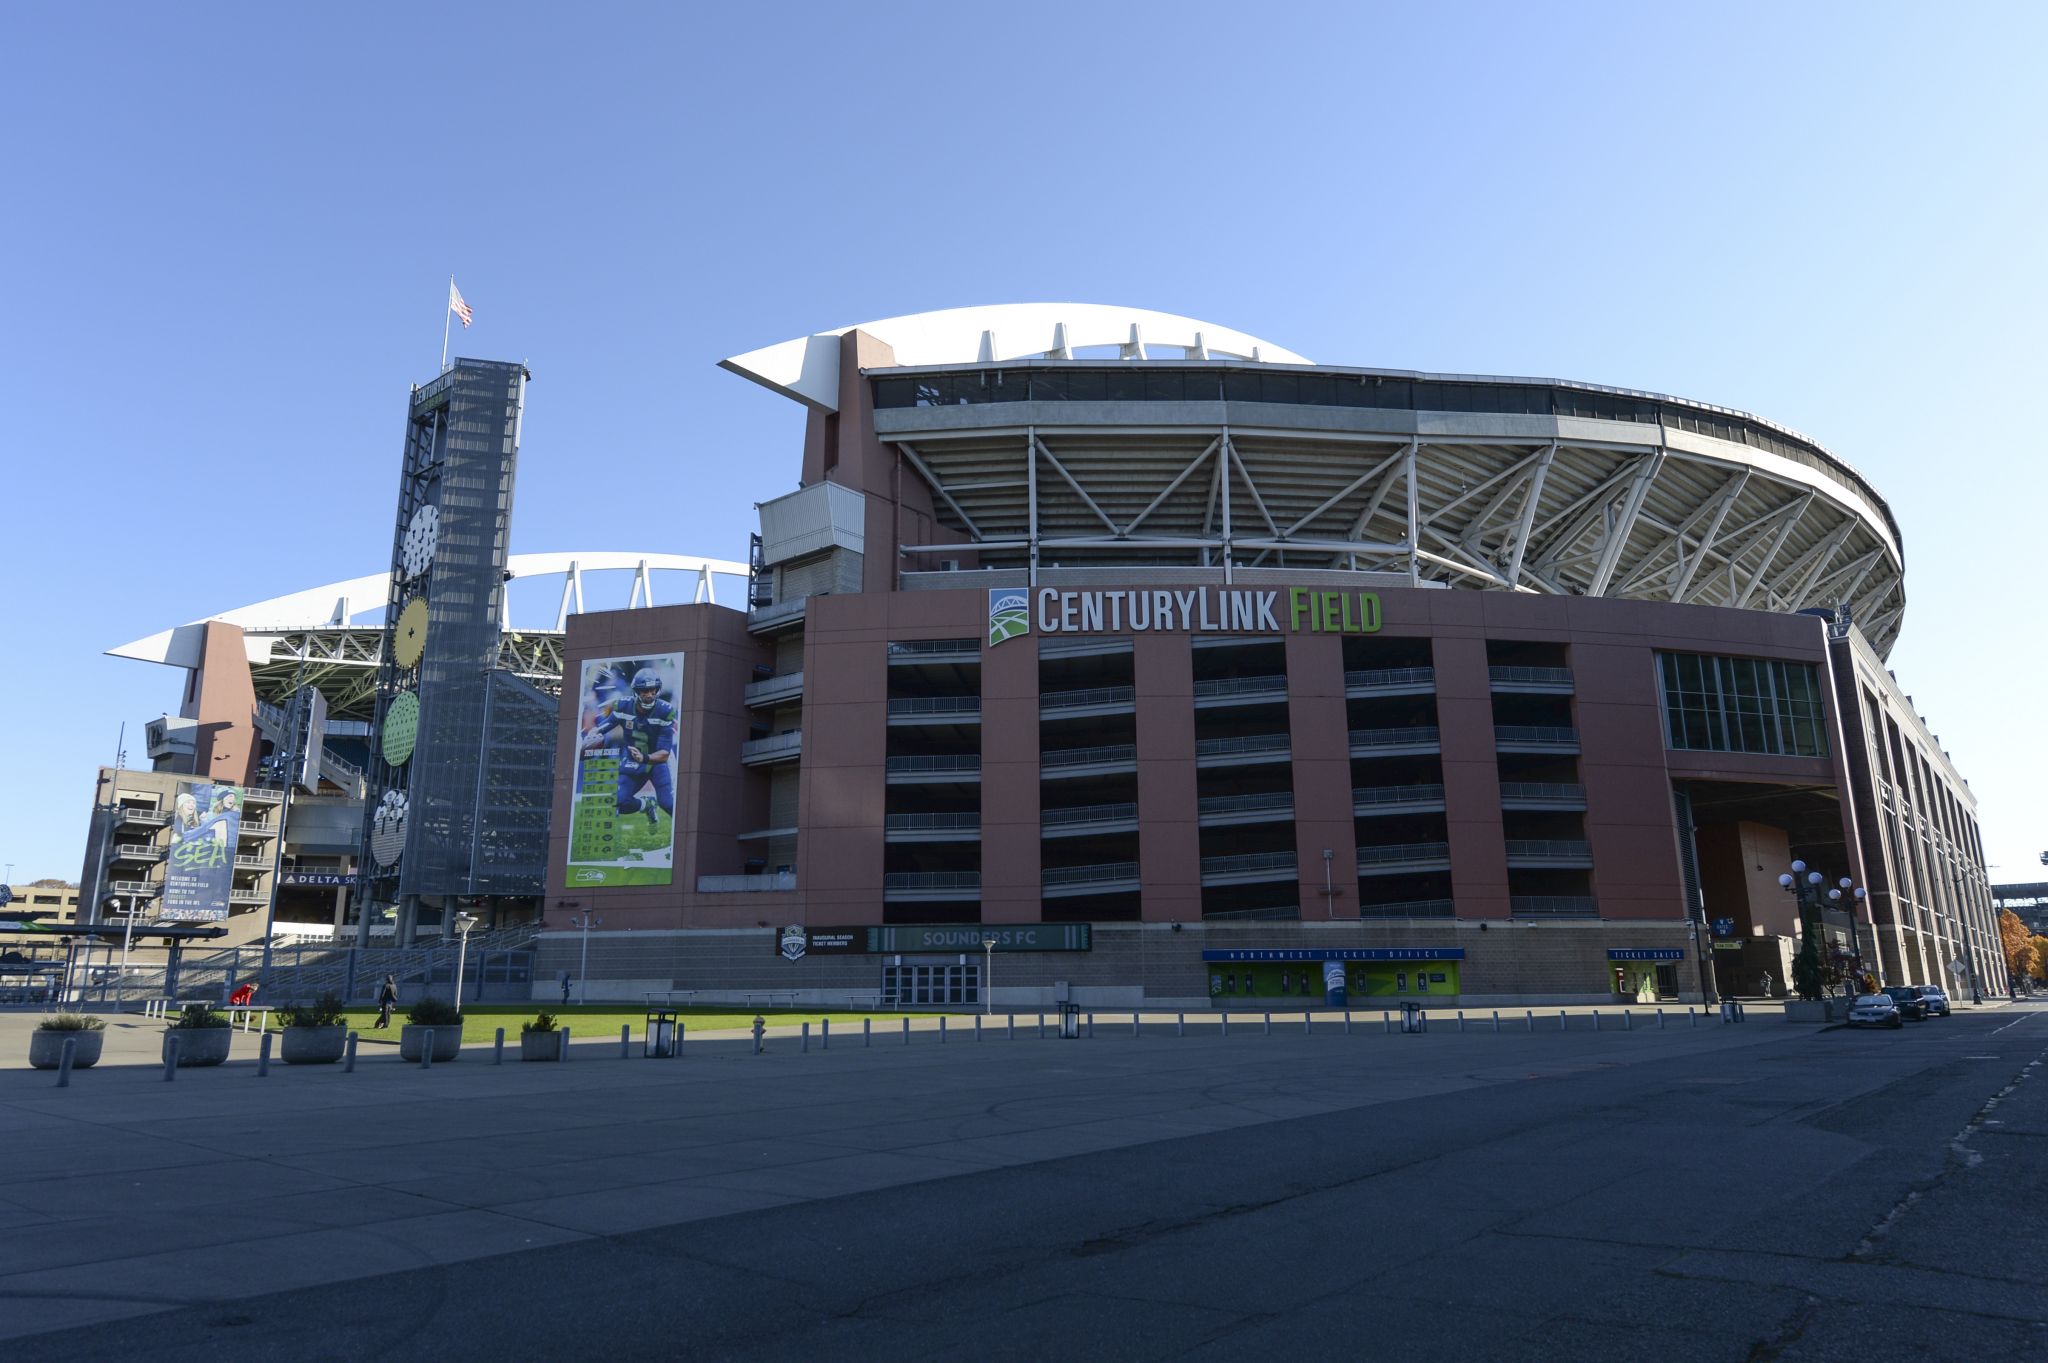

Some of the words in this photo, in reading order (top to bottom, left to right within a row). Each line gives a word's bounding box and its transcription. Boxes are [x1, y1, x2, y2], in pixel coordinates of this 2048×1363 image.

[1037, 586, 1280, 632] CENTURYLINK
[1289, 587, 1382, 633] FIELD
[173, 838, 228, 869] SEA
[298, 875, 340, 884] DELTA
[923, 931, 1011, 946] SOUNDERS
[1015, 930, 1037, 945] FC
[1230, 951, 1314, 960] NORTHWEST
[1326, 951, 1376, 959] TICKET
[1389, 950, 1440, 960] OFFICE
[1615, 951, 1646, 959] TICKET
[1653, 951, 1681, 959] SALES
